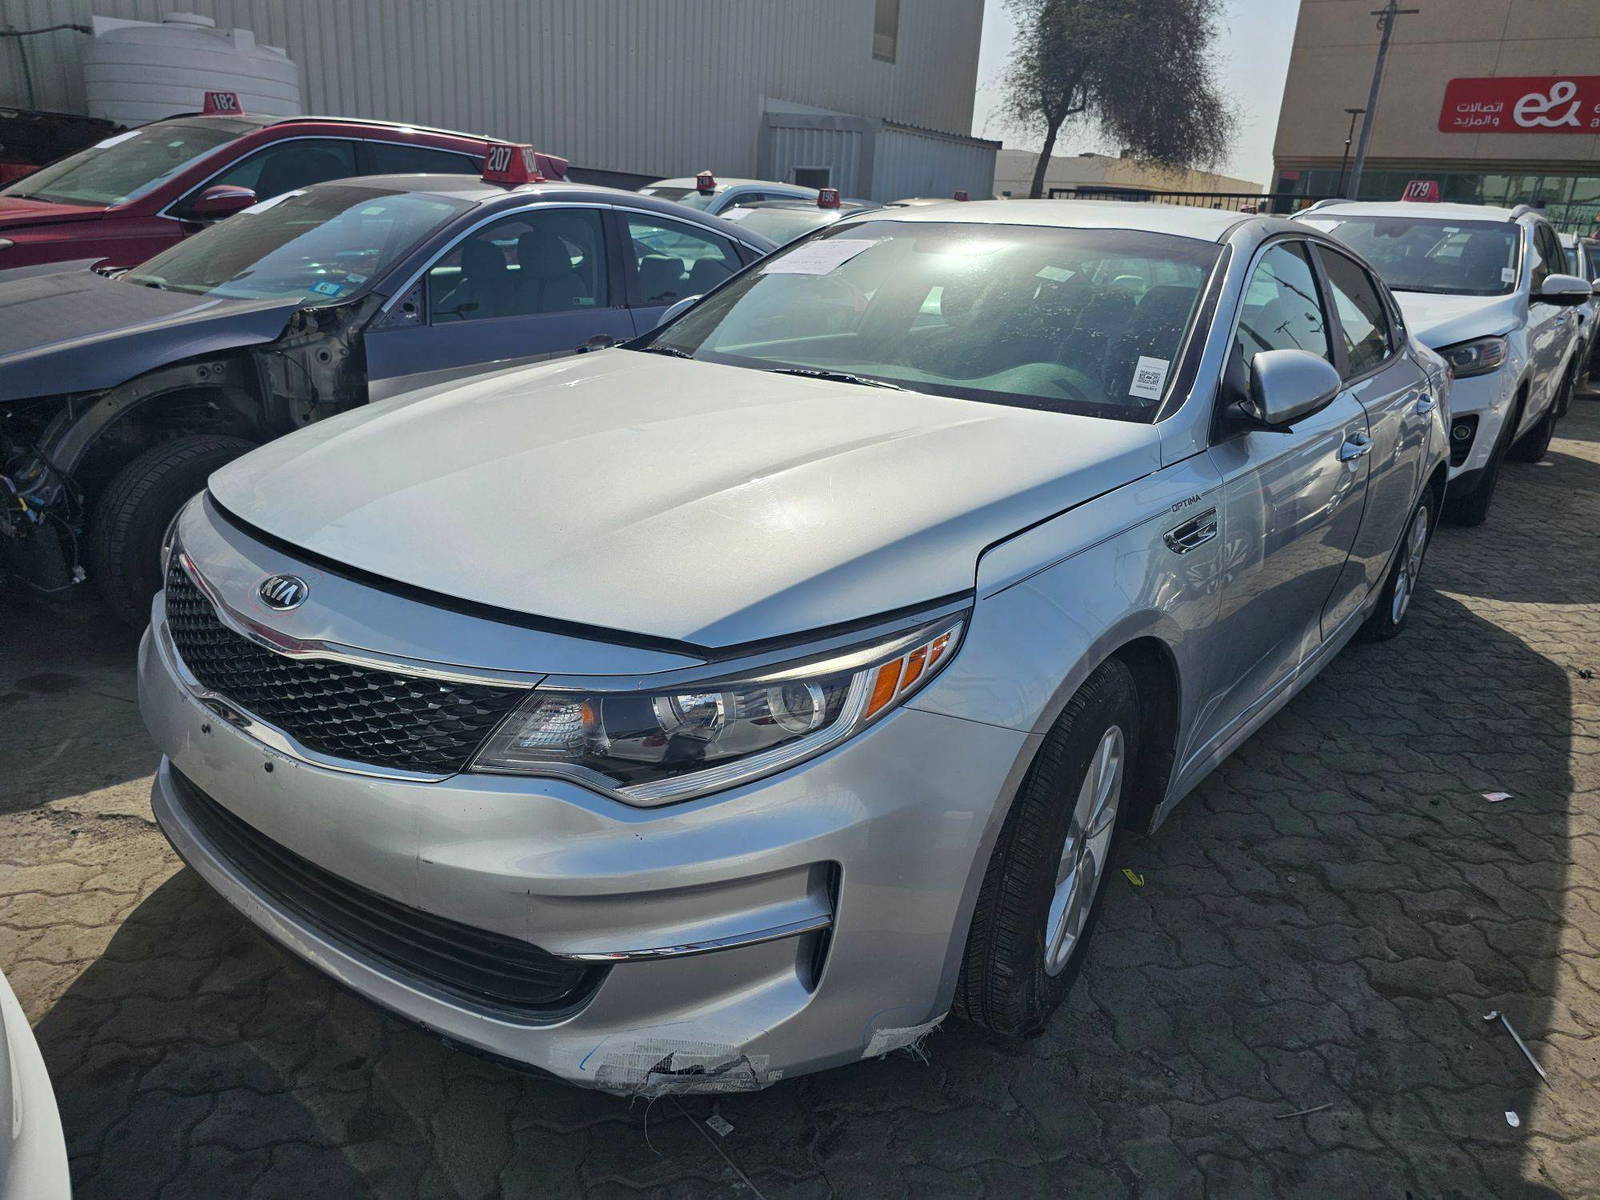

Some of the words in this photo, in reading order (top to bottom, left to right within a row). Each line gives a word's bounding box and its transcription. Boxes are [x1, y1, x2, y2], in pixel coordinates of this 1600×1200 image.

[213, 94, 237, 110] 182
[1456, 102, 1504, 113] اتصالات
[1453, 114, 1500, 127] والمزيد
[487, 146, 512, 172] 207
[1409, 182, 1430, 197] 179
[1171, 494, 1202, 512] OPTIMA
[260, 576, 299, 605] KIA
